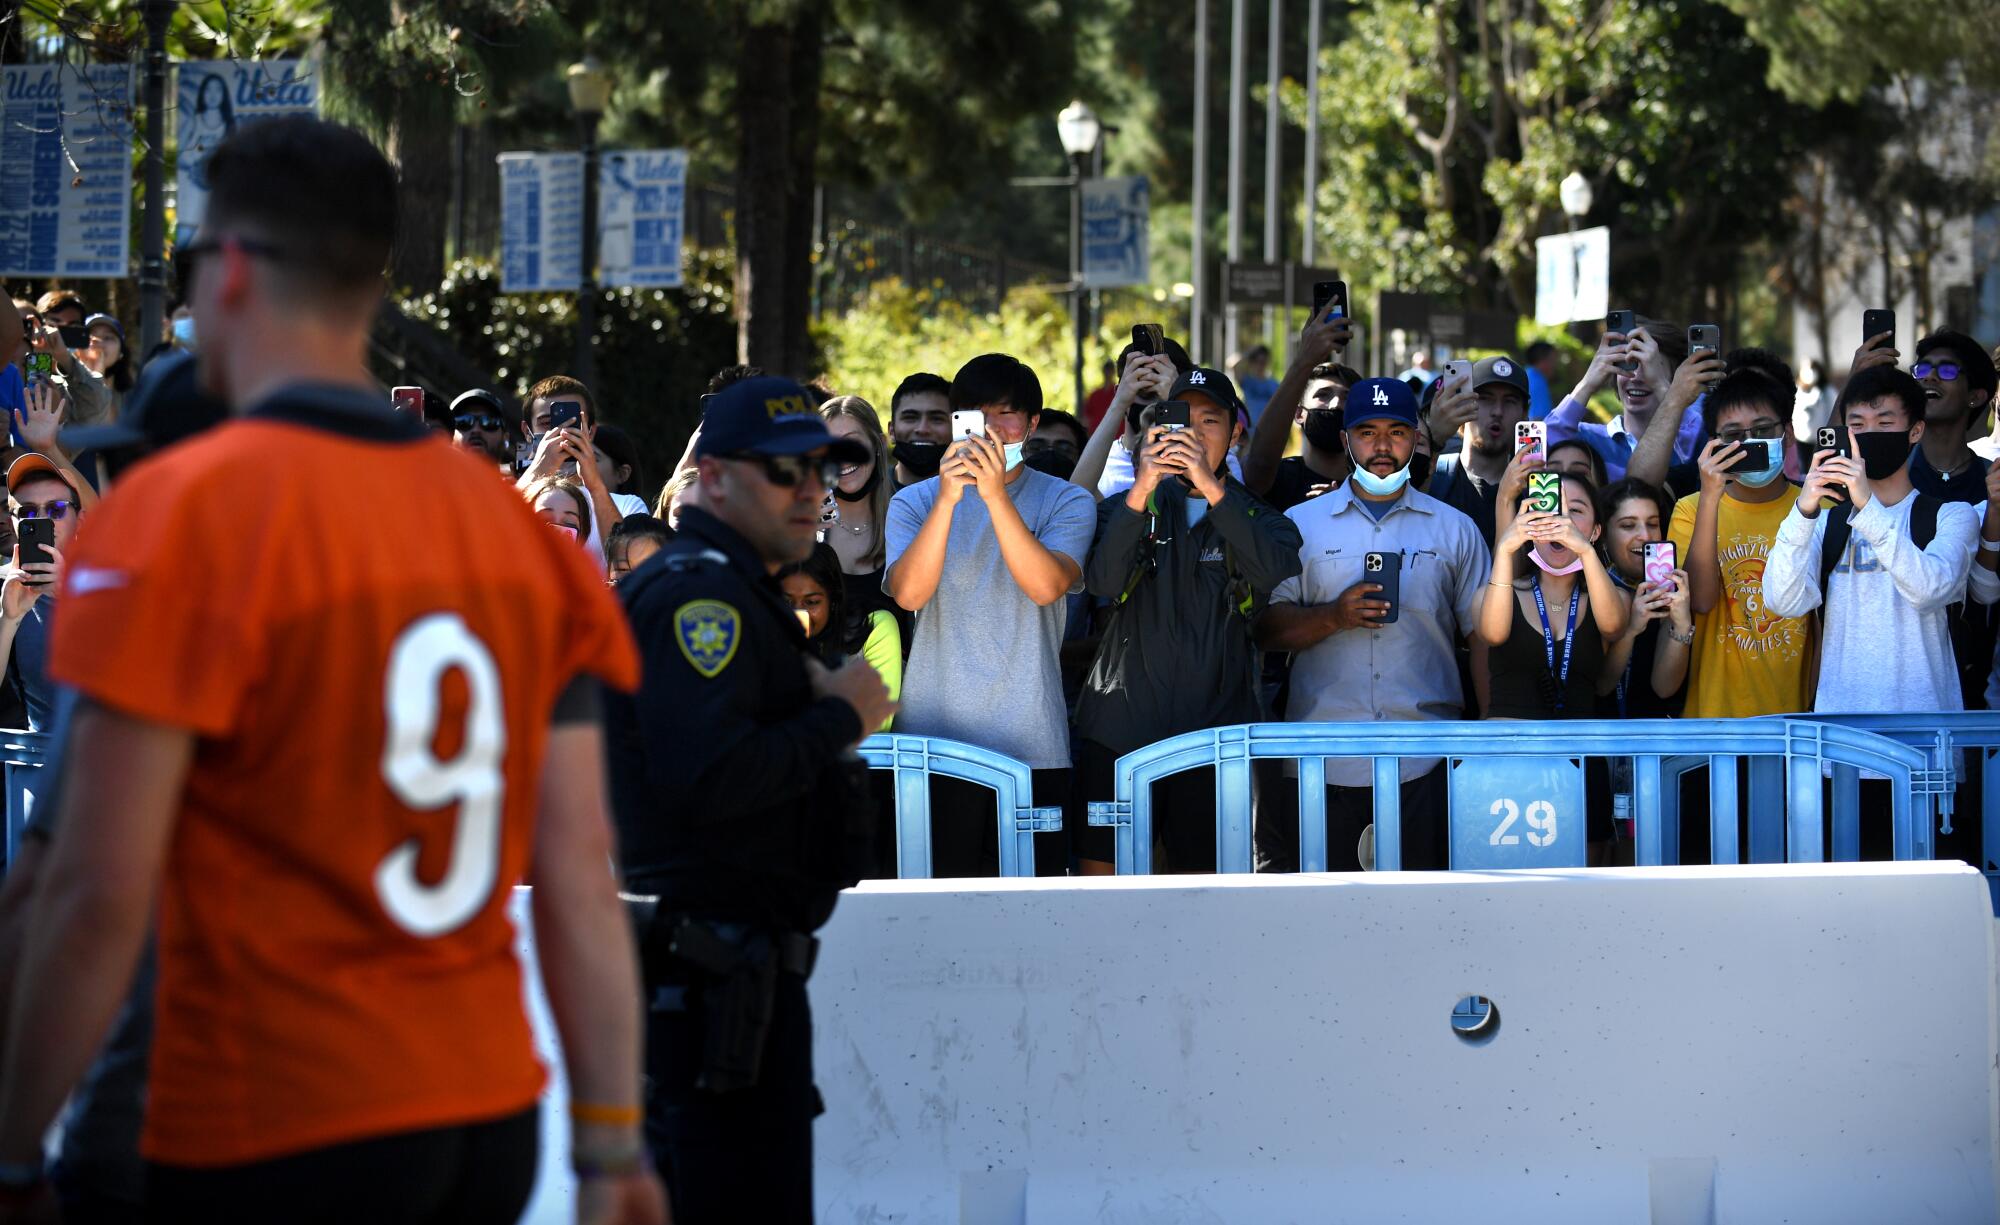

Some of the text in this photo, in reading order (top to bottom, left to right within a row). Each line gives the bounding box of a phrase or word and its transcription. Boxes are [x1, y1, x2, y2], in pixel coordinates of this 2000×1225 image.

[6, 70, 62, 99] Ucla
[234, 66, 312, 105] Ucla
[28, 211, 59, 272] HOME
[1190, 371, 1206, 384] LA
[1373, 385, 1389, 405] LA
[1740, 586, 1763, 595] AREA
[1544, 627, 1552, 645] UCLA
[1560, 632, 1573, 680] UCLA BRUINS
[375, 611, 507, 938] 9
[1490, 798, 1557, 847] 29
